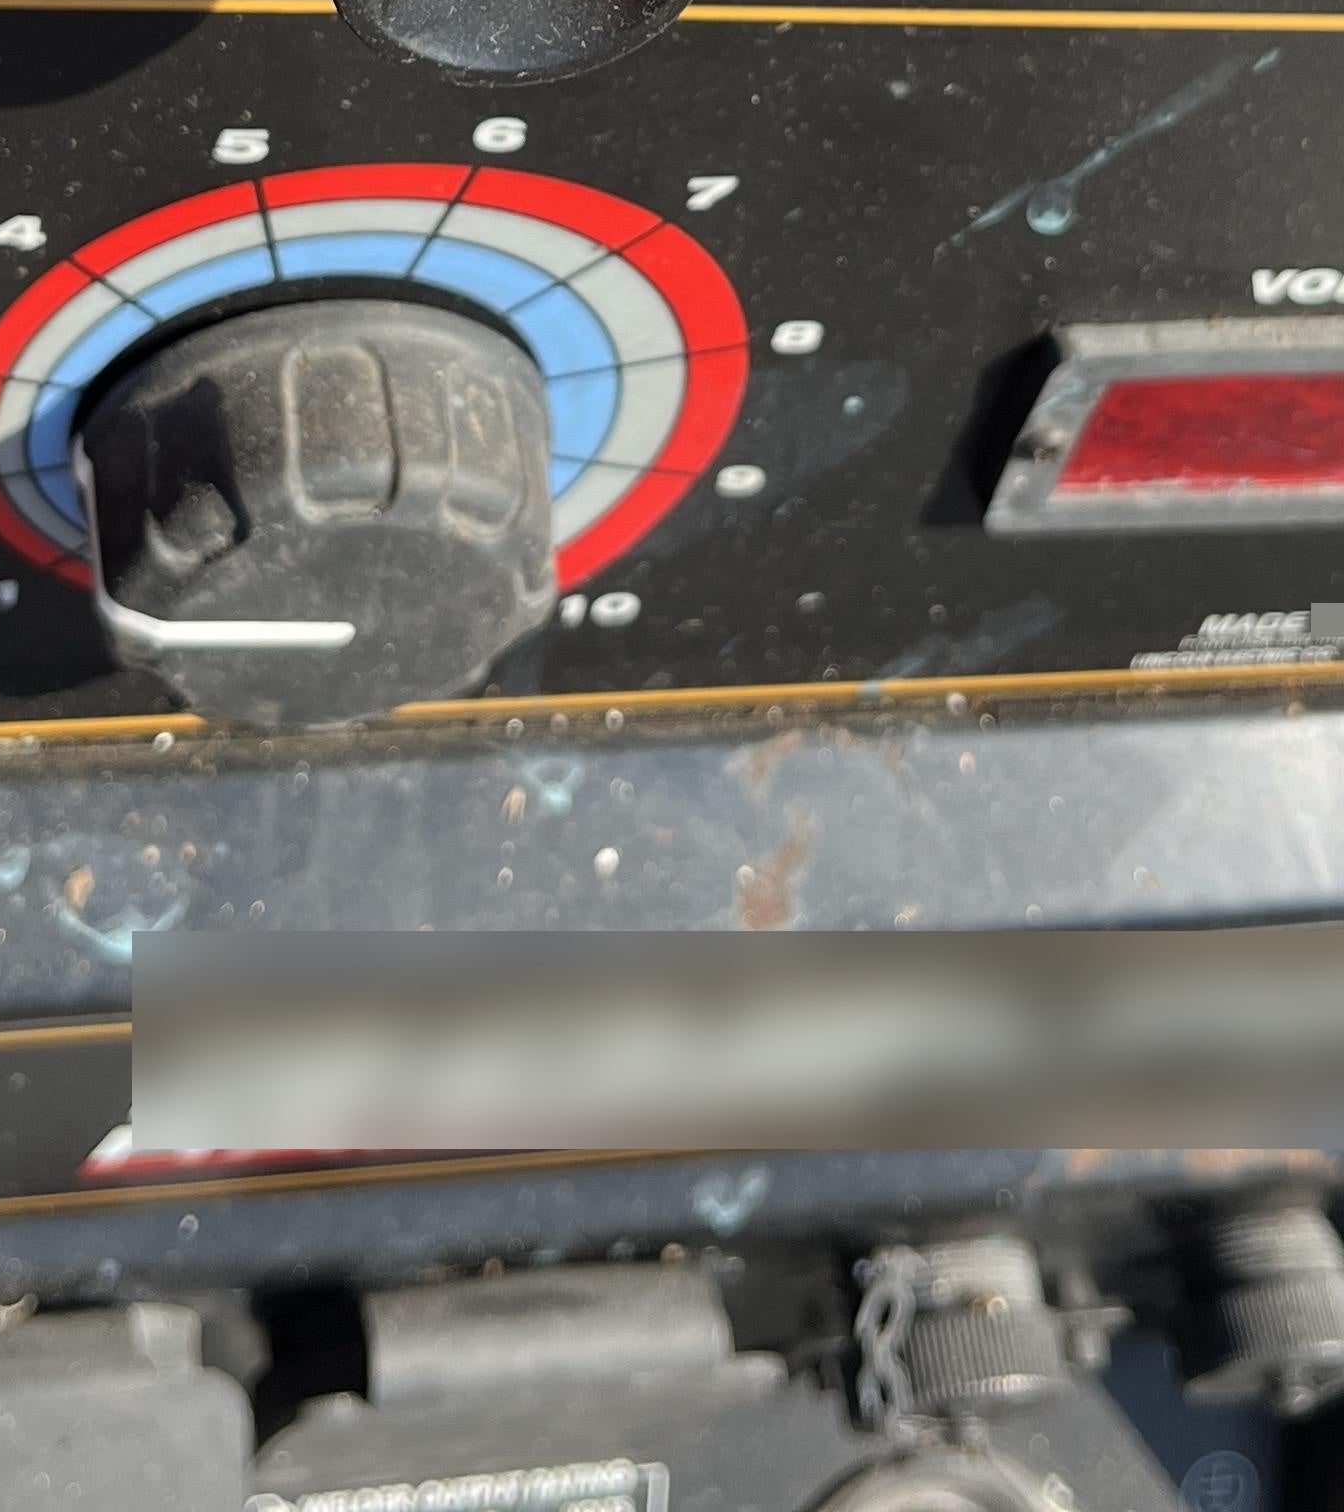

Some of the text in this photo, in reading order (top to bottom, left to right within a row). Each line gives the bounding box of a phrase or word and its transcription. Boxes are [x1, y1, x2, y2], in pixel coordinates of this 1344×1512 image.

[212, 128, 270, 164] 5
[473, 116, 527, 153] 6
[686, 175, 739, 211] 7
[770, 320, 824, 355] 8
[559, 592, 641, 627] 10
